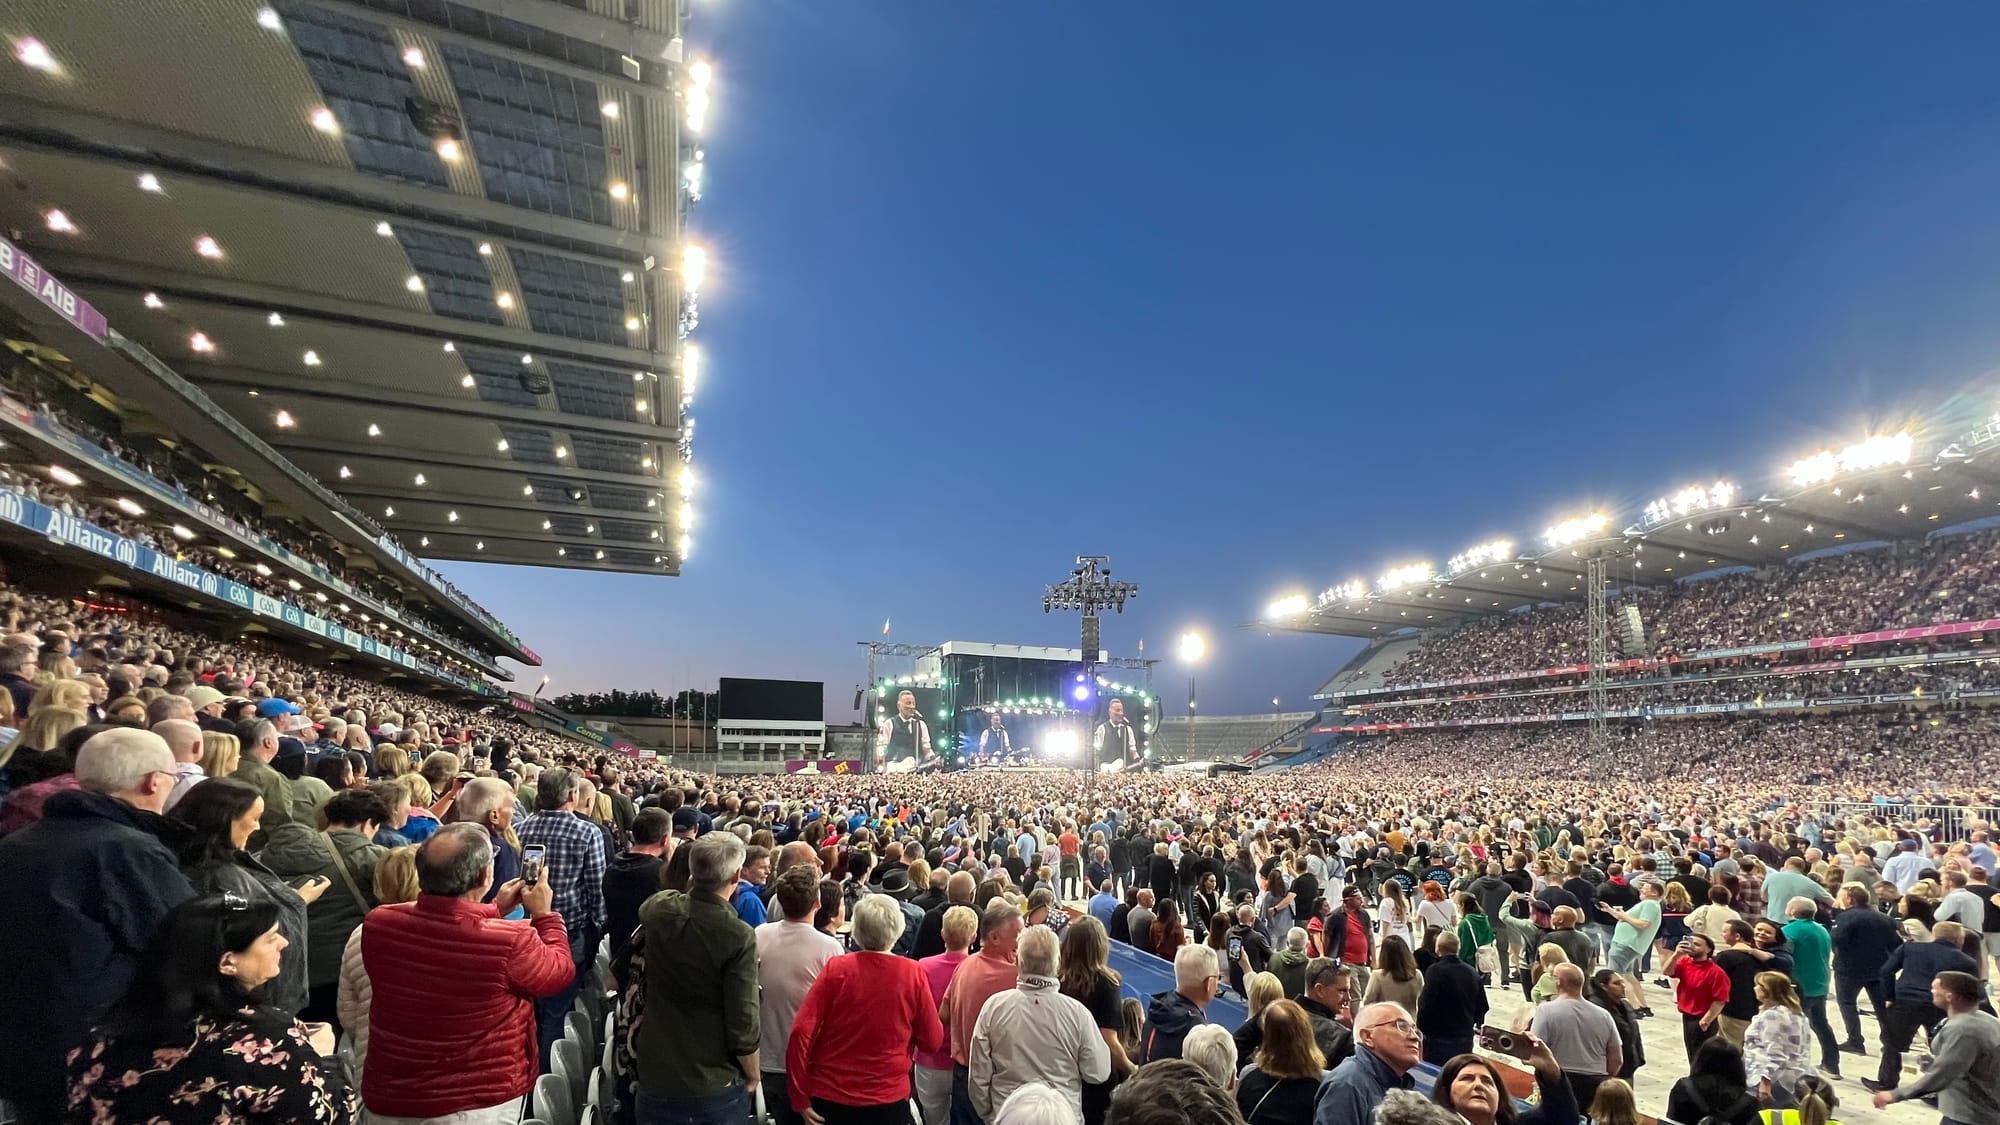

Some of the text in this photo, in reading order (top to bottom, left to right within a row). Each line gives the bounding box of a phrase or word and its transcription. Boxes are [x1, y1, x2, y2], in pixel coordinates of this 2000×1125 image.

[41, 279, 75, 316] AIB
[46, 509, 113, 557] Allianz
[152, 553, 200, 589] Allianz
[230, 585, 249, 605] GAA
[259, 597, 275, 614] GAA
[285, 608, 300, 624] GAA
[1695, 704, 1727, 713] Allianz
[575, 726, 603, 742] Centra
